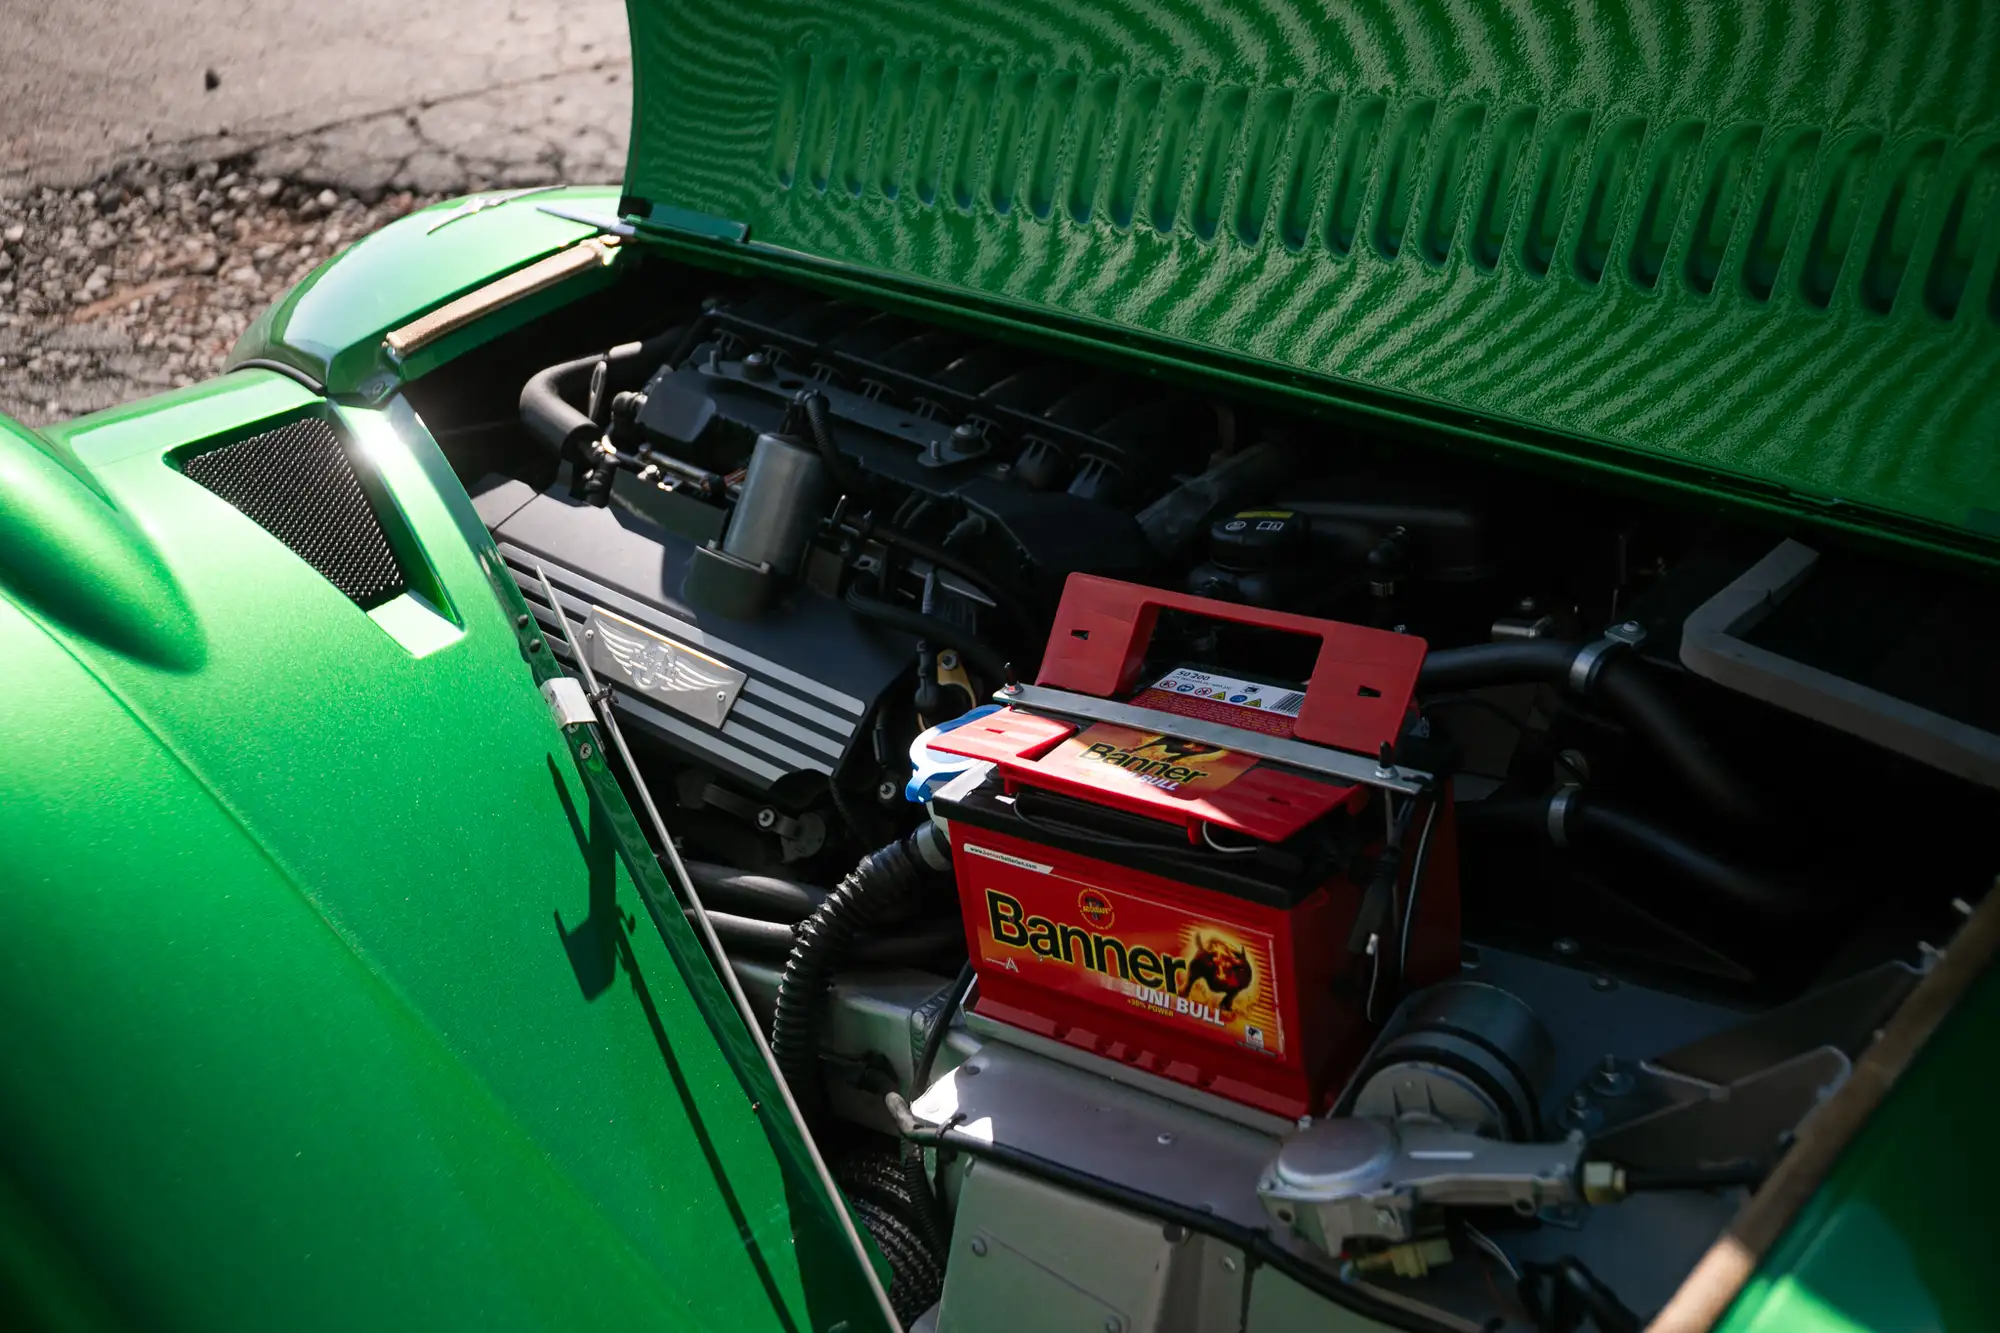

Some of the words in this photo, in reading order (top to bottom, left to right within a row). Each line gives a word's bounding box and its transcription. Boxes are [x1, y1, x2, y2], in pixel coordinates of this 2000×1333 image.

[1078, 742, 1208, 783] Banner
[985, 888, 1187, 996] Banner
[1135, 986, 1170, 1008] UNI
[1176, 996, 1224, 1027] BULL
[1148, 1002, 1174, 1018] POWER
